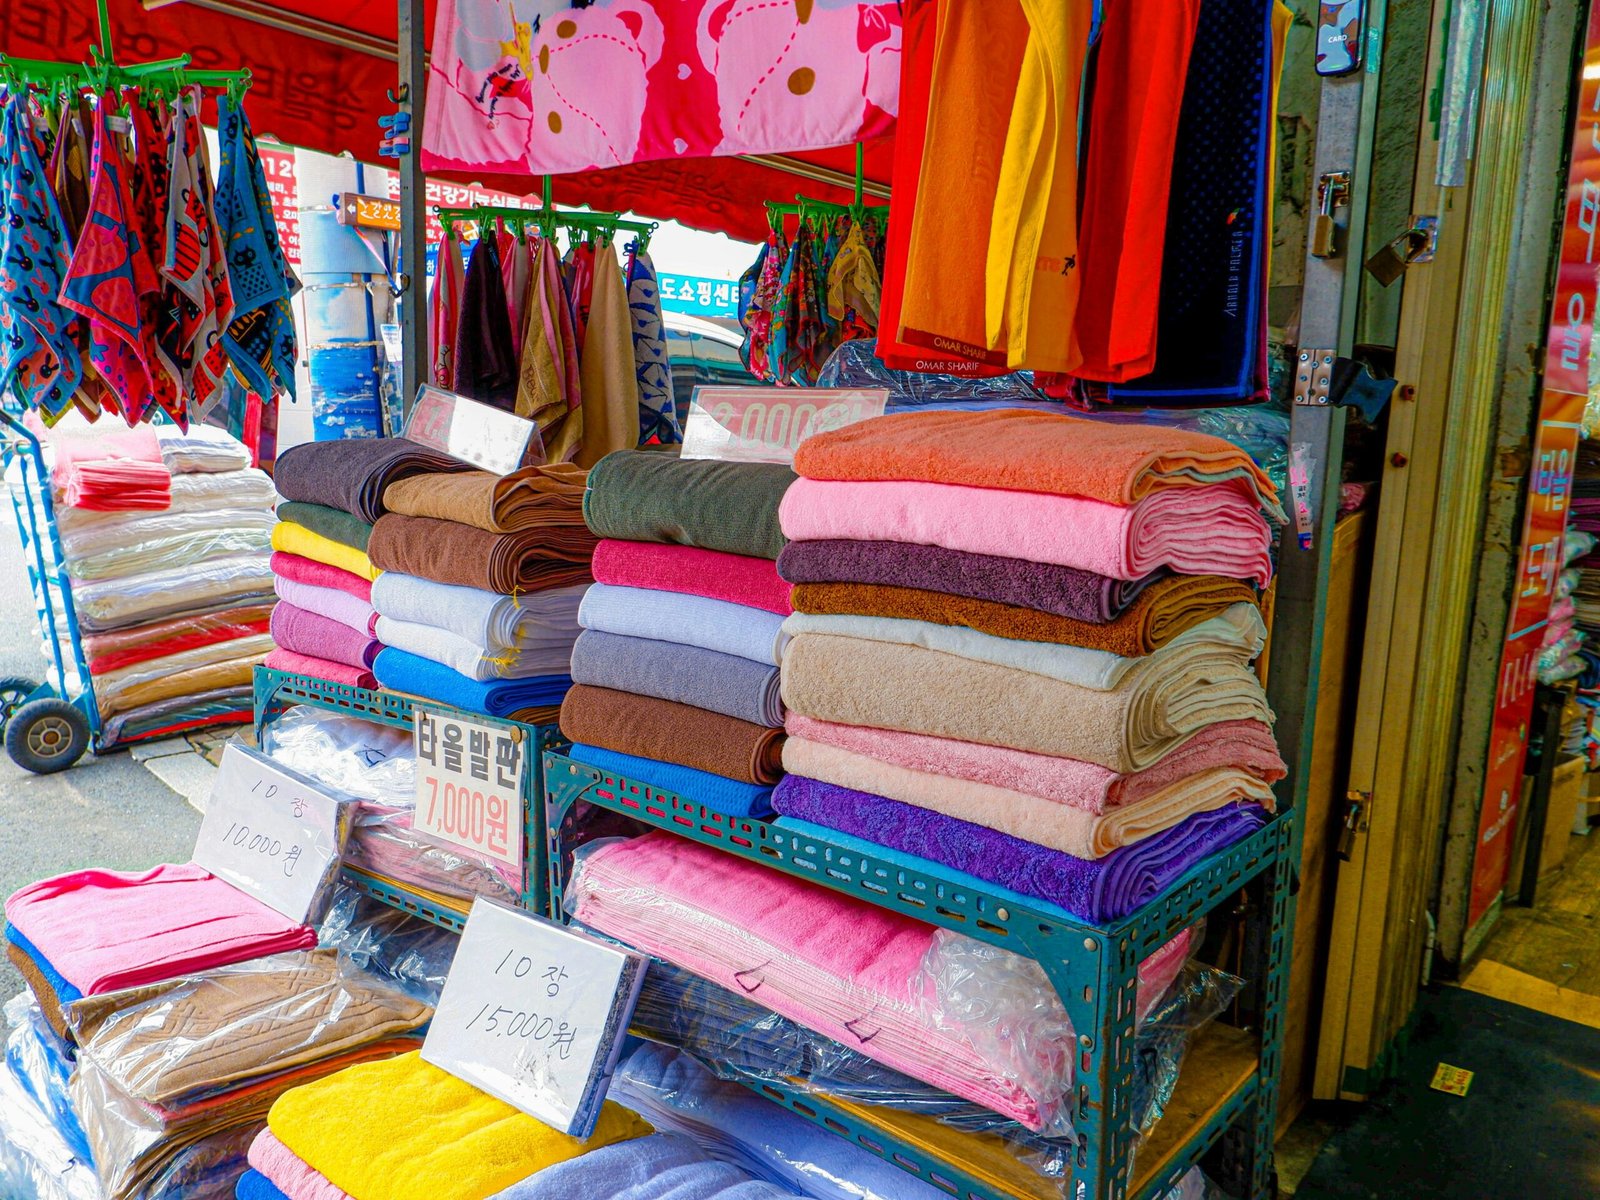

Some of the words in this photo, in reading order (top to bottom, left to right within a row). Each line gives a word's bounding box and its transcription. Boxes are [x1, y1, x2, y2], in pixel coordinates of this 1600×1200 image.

[1327, 34, 1348, 43] CARD
[915, 360, 945, 370] OMAR
[947, 361, 980, 371] SHARIF
[934, 337, 961, 353] OMAR
[962, 345, 987, 360] SHARIF
[418, 717, 521, 791] 타올발판
[251, 779, 278, 799] 10
[290, 797, 309, 818] 장
[425, 776, 508, 857] 7,000원
[494, 949, 532, 978] 10
[541, 965, 569, 998] 장
